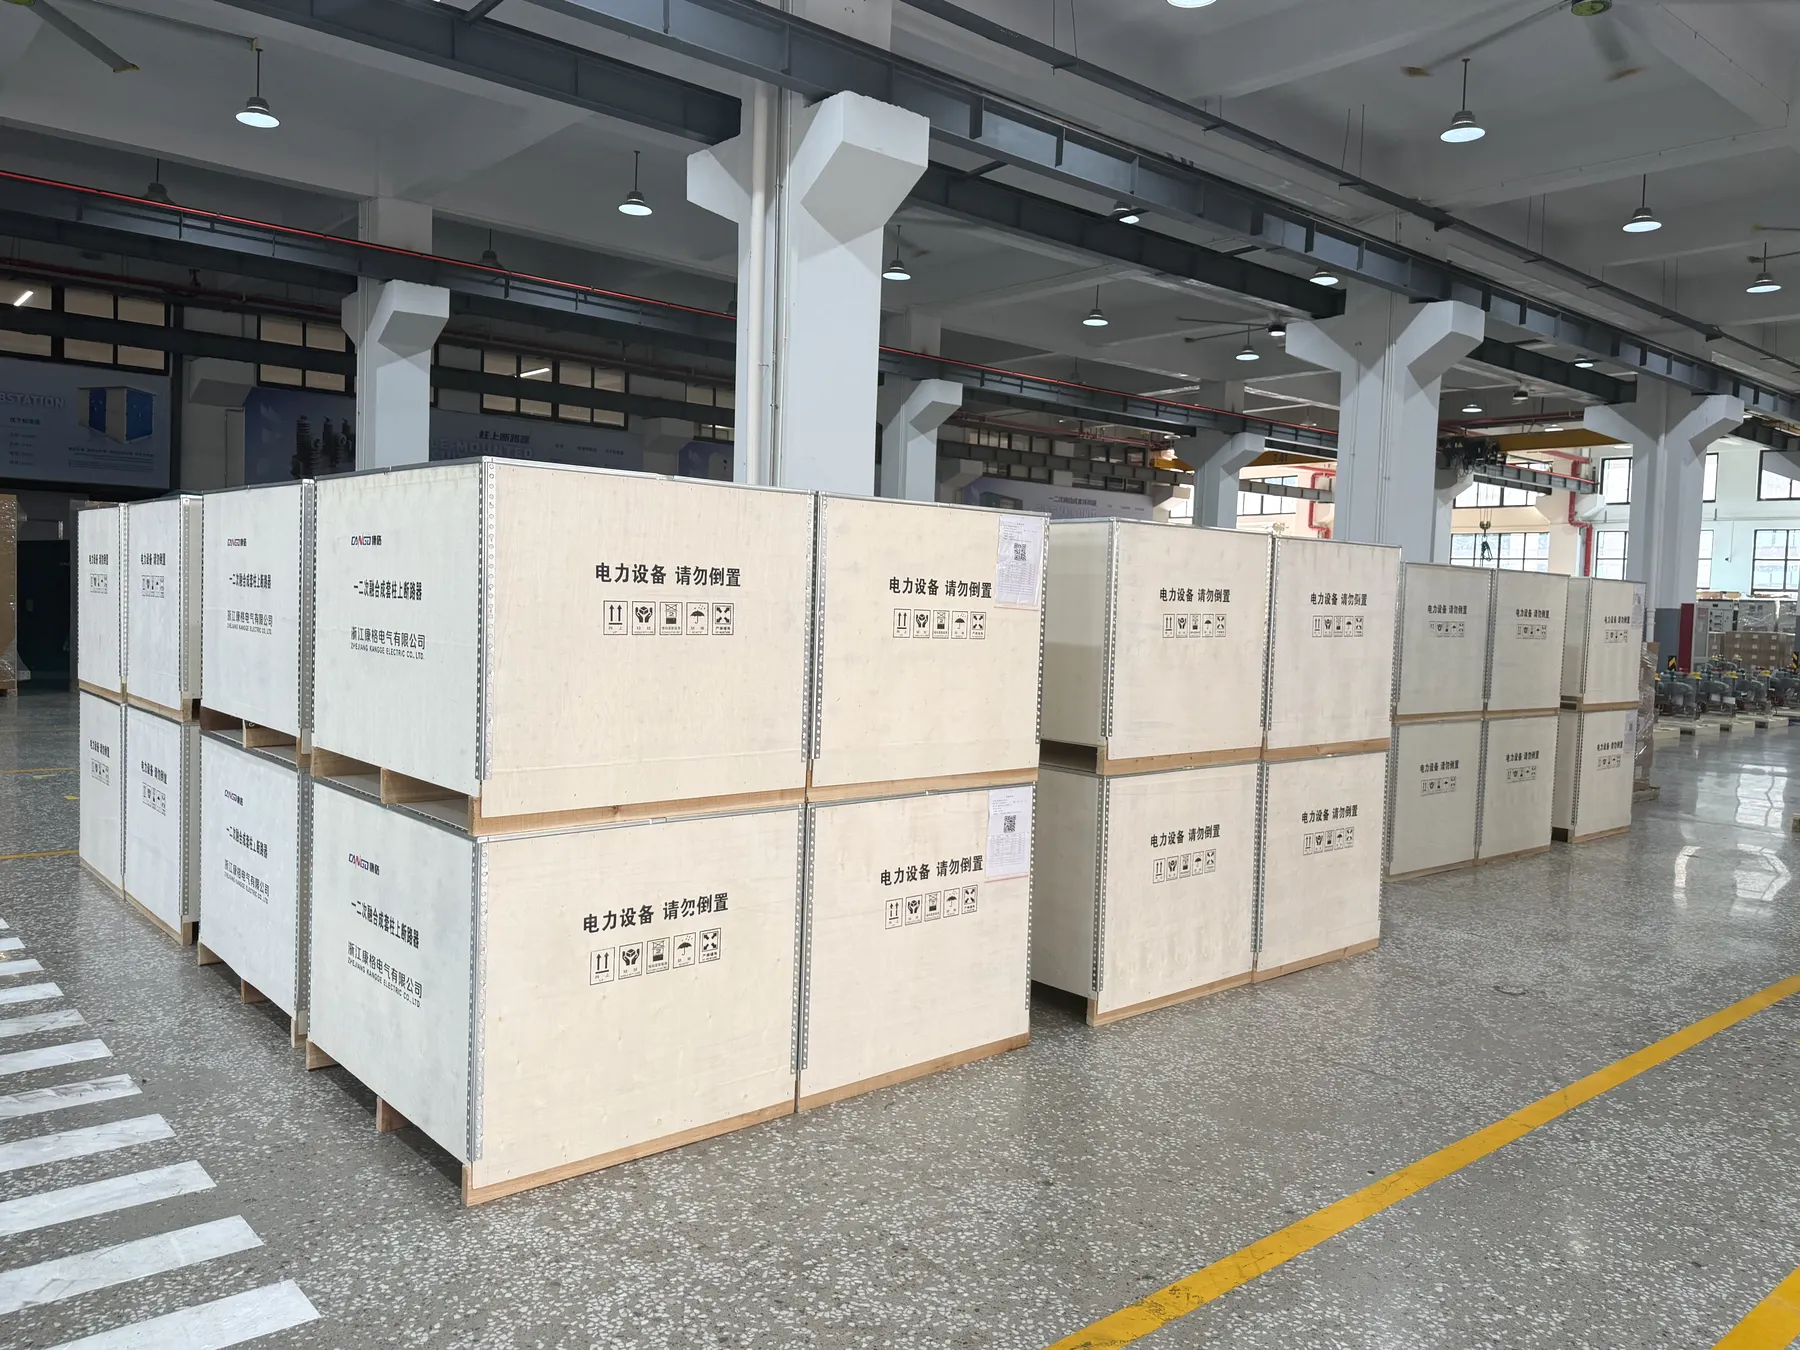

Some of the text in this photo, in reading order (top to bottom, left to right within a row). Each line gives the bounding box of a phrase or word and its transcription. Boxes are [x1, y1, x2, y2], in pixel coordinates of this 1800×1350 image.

[596, 562, 741, 587] 电力设备 请勿倒置
[354, 579, 422, 601] 一二次融合成套柱上断路器
[889, 576, 992, 599] 电力设备 请勿倒置
[1160, 587, 1231, 603] 电力设备 请勿倒置
[1310, 592, 1367, 606] 电力设备 请勿倒置
[351, 626, 426, 650] 浙江康格电气有限公司
[386, 647, 405, 657] ELECTRIC
[1302, 804, 1358, 824] 电力设备 请勿倒置
[1150, 824, 1220, 848] 电力设备 请勿倒置
[880, 855, 983, 886] 电力设备 请勿倒置
[351, 900, 420, 949] 一二次融合成套柱上断路器
[583, 892, 728, 934] 电力设备 请勿倒置
[348, 940, 422, 999] 浙江康格电气有限公司
